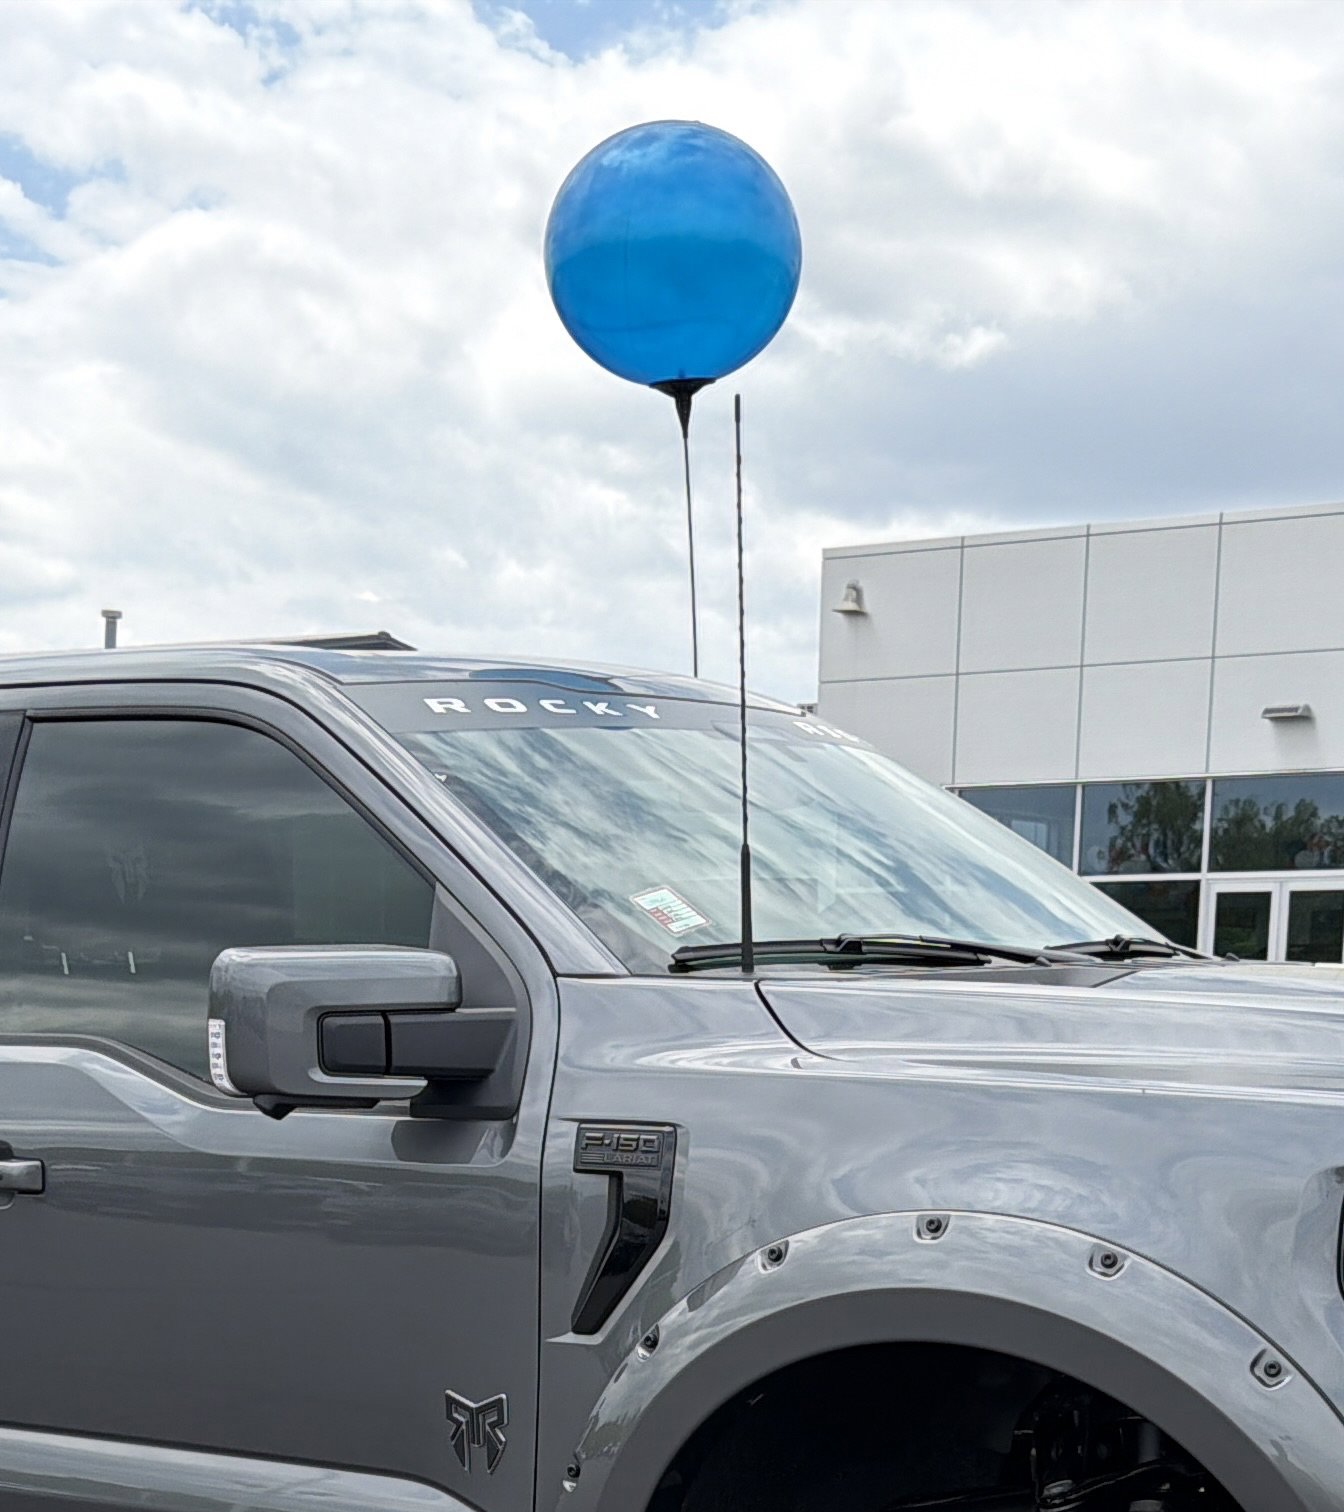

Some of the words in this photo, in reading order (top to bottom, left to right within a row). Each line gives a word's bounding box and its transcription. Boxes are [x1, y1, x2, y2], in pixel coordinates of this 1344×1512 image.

[423, 698, 660, 720] ROCKY
[581, 1132, 660, 1153] F-150
[604, 1152, 655, 1164] LARIAT
